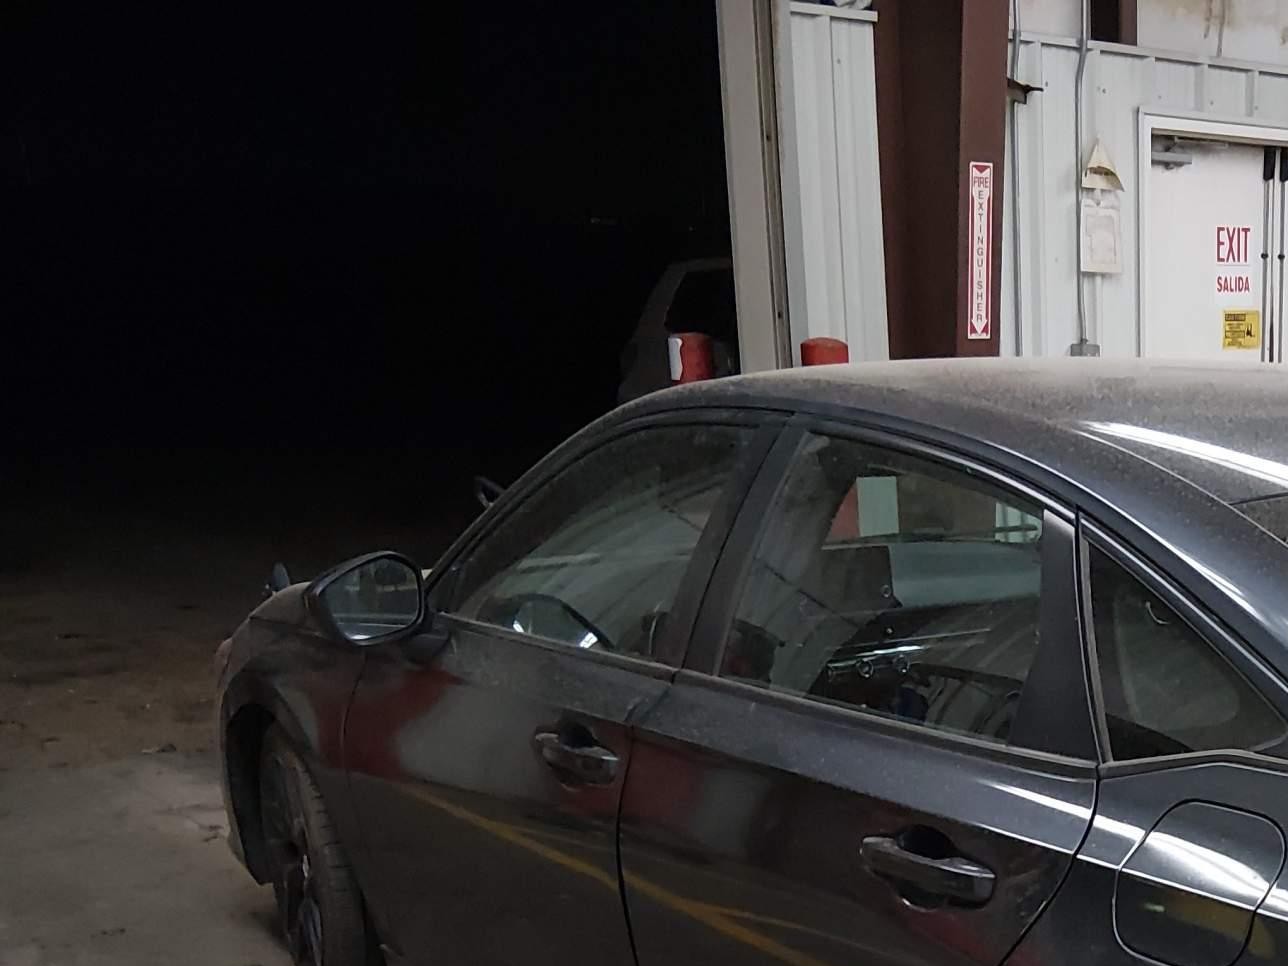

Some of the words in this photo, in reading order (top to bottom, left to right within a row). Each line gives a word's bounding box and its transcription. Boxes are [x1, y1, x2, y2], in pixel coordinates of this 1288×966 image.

[973, 176, 989, 189] FIRE
[976, 190, 985, 323] EXTINGUISHER
[1216, 226, 1251, 263] EXIT
[1216, 275, 1250, 293] SALIDA
